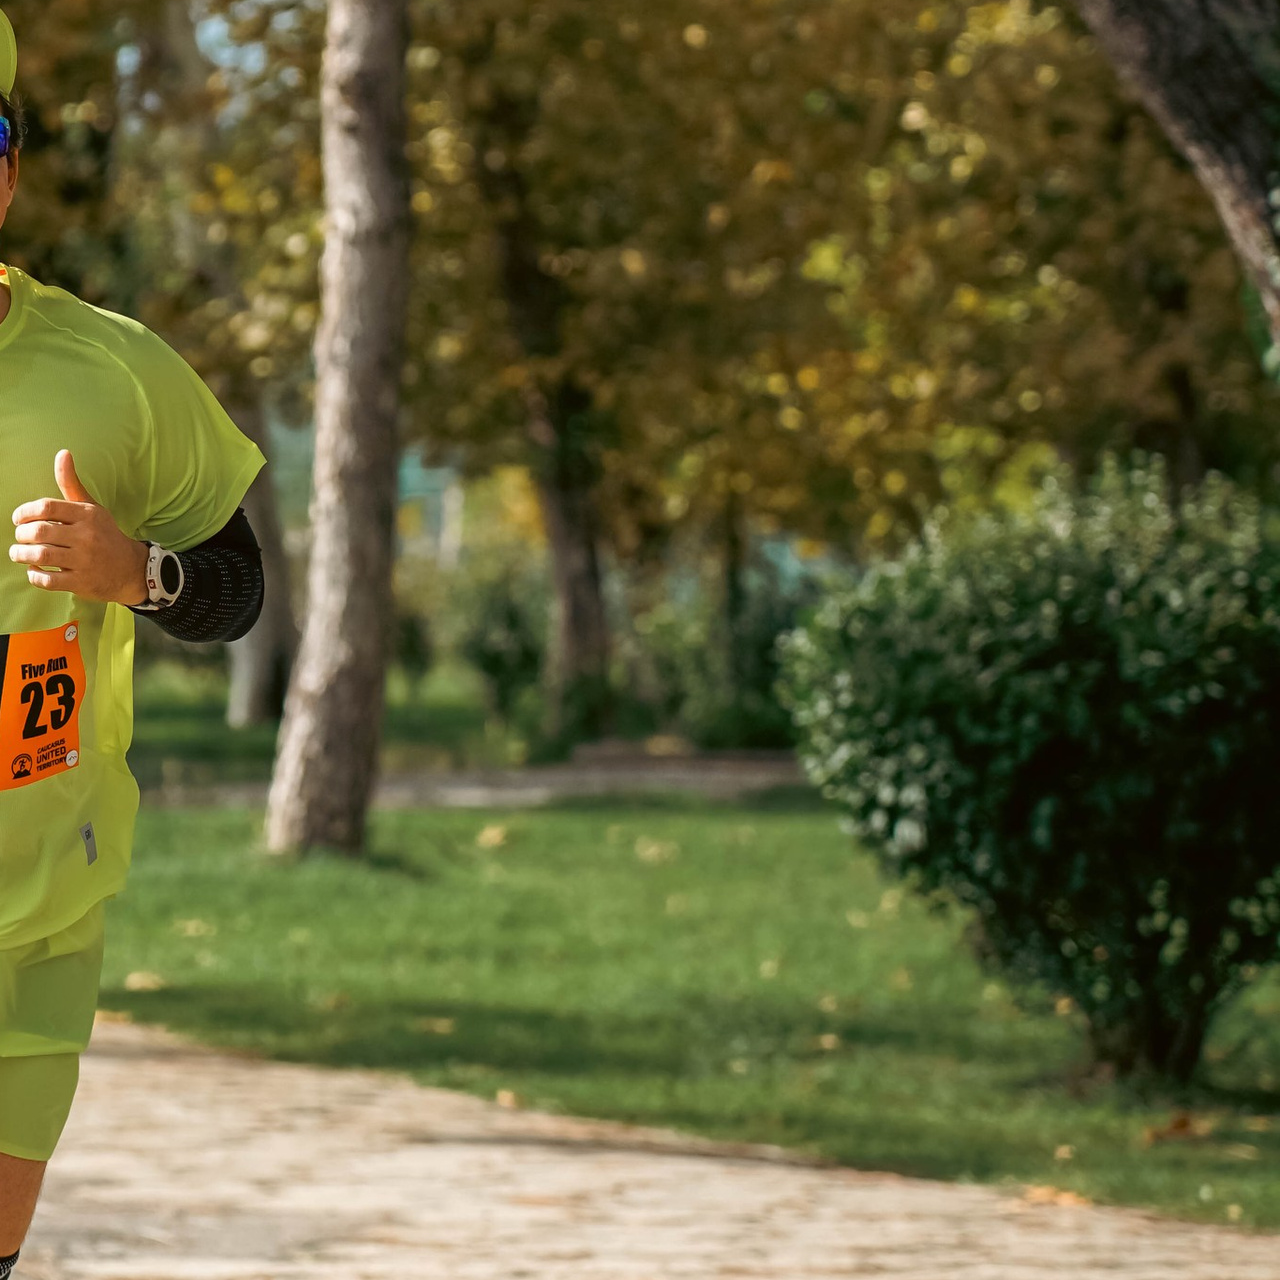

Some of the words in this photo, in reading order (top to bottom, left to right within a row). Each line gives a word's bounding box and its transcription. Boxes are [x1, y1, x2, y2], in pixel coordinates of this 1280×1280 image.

[21, 663, 45, 680] Five
[46, 656, 68, 674] Run
[21, 674, 75, 739] 23
[36, 746, 66, 764] UNITED
[37, 738, 66, 754] CAUCASUS
